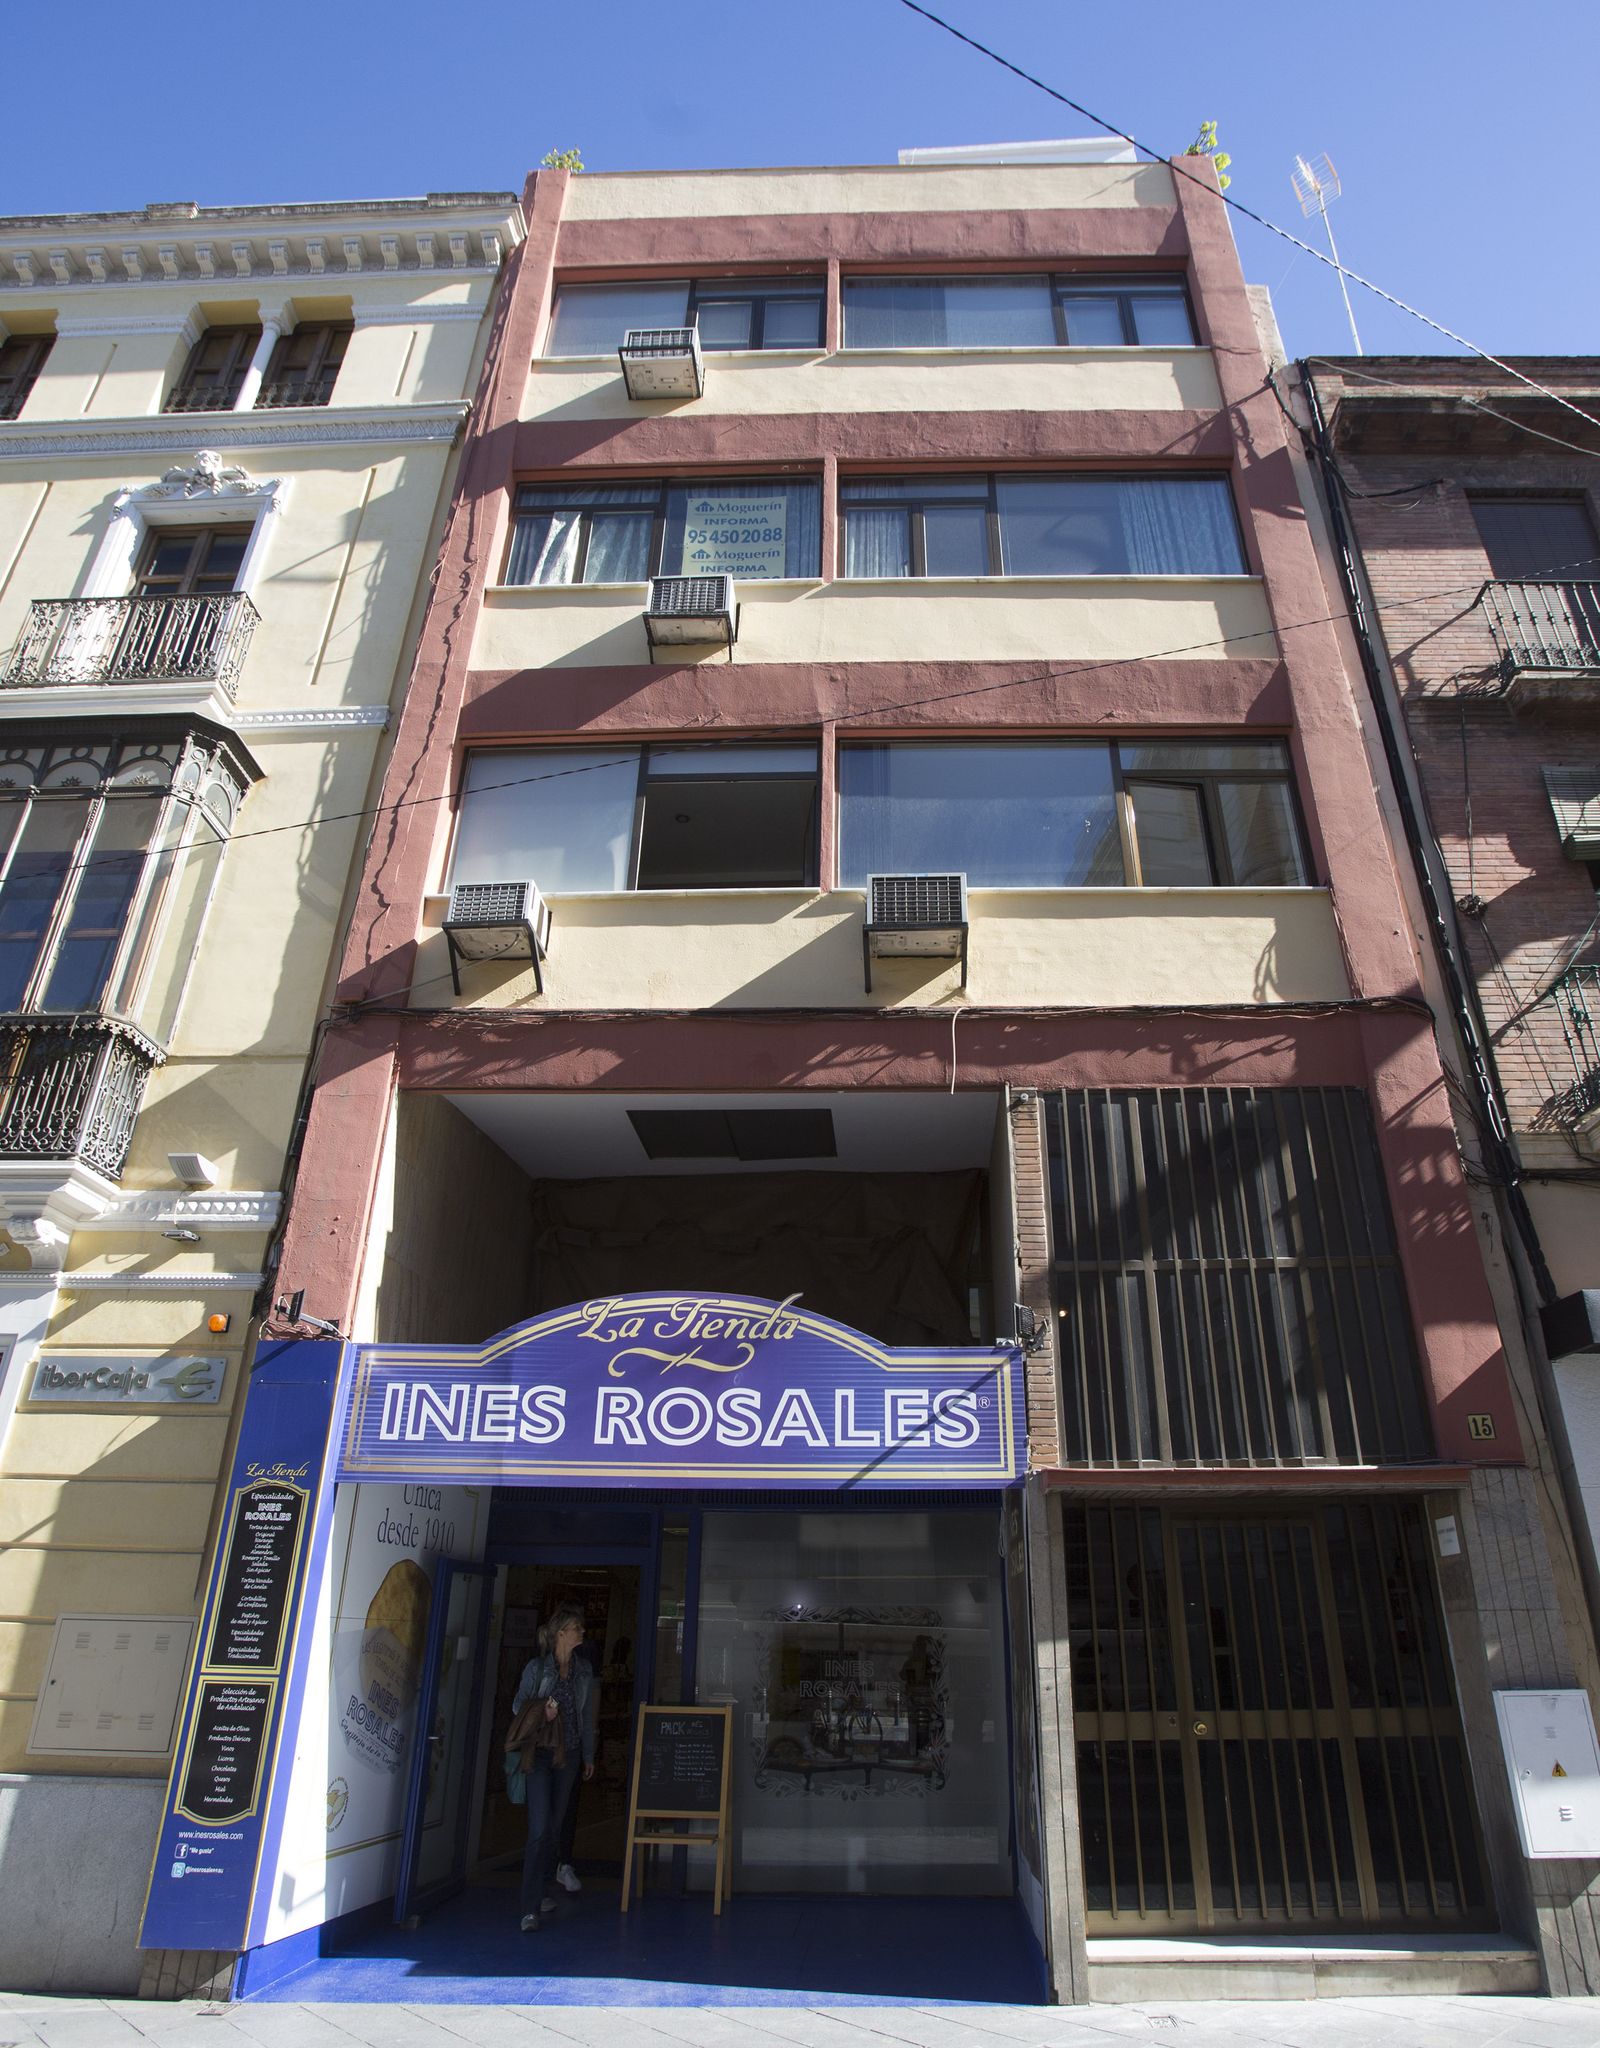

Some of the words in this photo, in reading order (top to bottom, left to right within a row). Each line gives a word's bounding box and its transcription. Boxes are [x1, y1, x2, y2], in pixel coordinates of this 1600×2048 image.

[716, 501, 782, 514] Moguerín
[704, 517, 769, 526] INFORMA
[713, 548, 780, 561] Moguerín
[700, 564, 767, 573] INFORMA
[577, 1298, 646, 1342] La
[653, 1292, 804, 1340] Tienda
[379, 1382, 565, 1444] INES
[1472, 1417, 1492, 1436] 15
[246, 1463, 265, 1477] La
[267, 1461, 311, 1476] Tienda
[251, 1492, 295, 1501] Especialidades
[257, 1503, 283, 1512] INES
[244, 1511, 292, 1521] ROSALES
[377, 1507, 420, 1548] desde
[424, 1517, 455, 1554] 1910
[825, 1660, 874, 1678] INES
[800, 1680, 902, 1698] ROSALES
[210, 1695, 238, 1703] Productos
[238, 1696, 266, 1704] Artesanos
[367, 1679, 400, 1720] INES
[346, 1694, 406, 1754] ROSALES
[661, 1721, 686, 1736] PACK
[214, 1775, 231, 1783] Quesos
[178, 1829, 244, 1840] www.inesrosales.com
